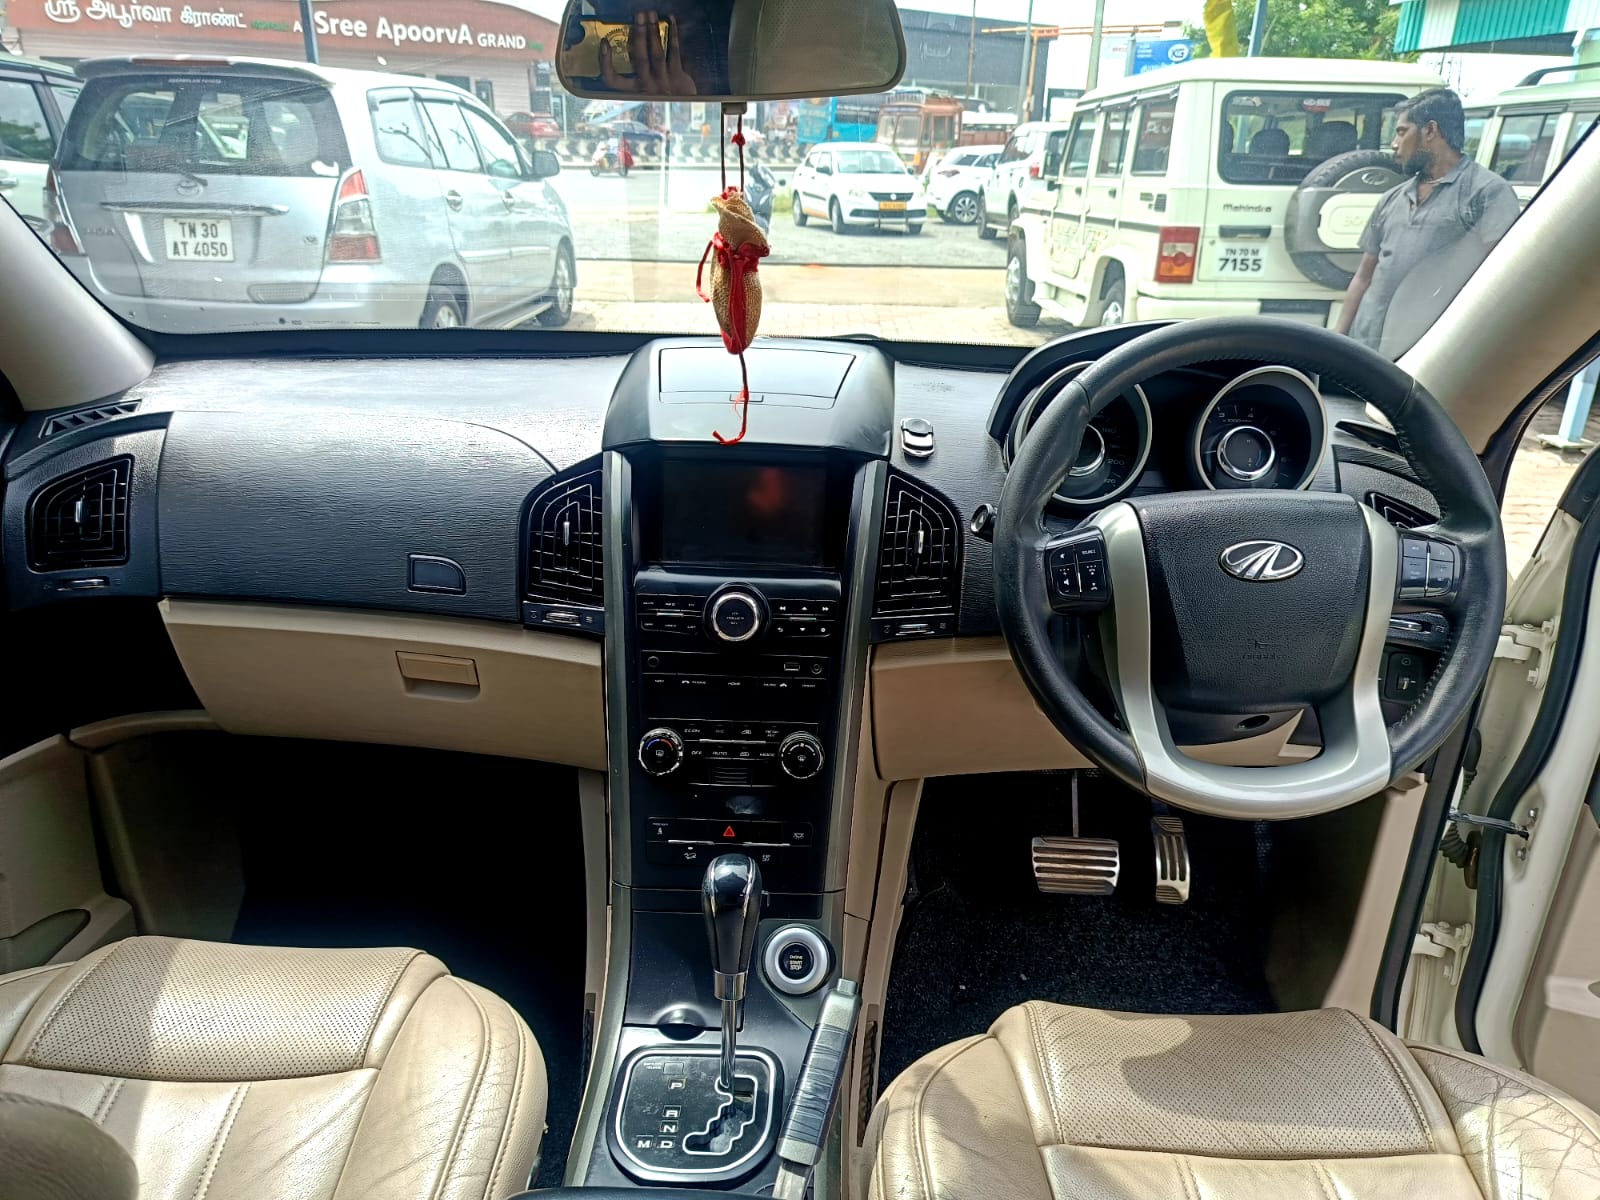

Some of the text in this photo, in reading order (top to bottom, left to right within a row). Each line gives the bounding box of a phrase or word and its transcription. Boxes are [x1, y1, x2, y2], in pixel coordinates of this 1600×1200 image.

[313, 10, 368, 38] Sree
[376, 17, 473, 46] ApoorvA
[477, 33, 526, 49] GRAND
[179, 222, 218, 239] TN 30
[172, 242, 228, 257] AT 4050
[1218, 258, 1262, 272] 7155
[665, 1109, 678, 1118] R
[663, 1124, 676, 1133] N
[637, 1140, 673, 1149] M D
